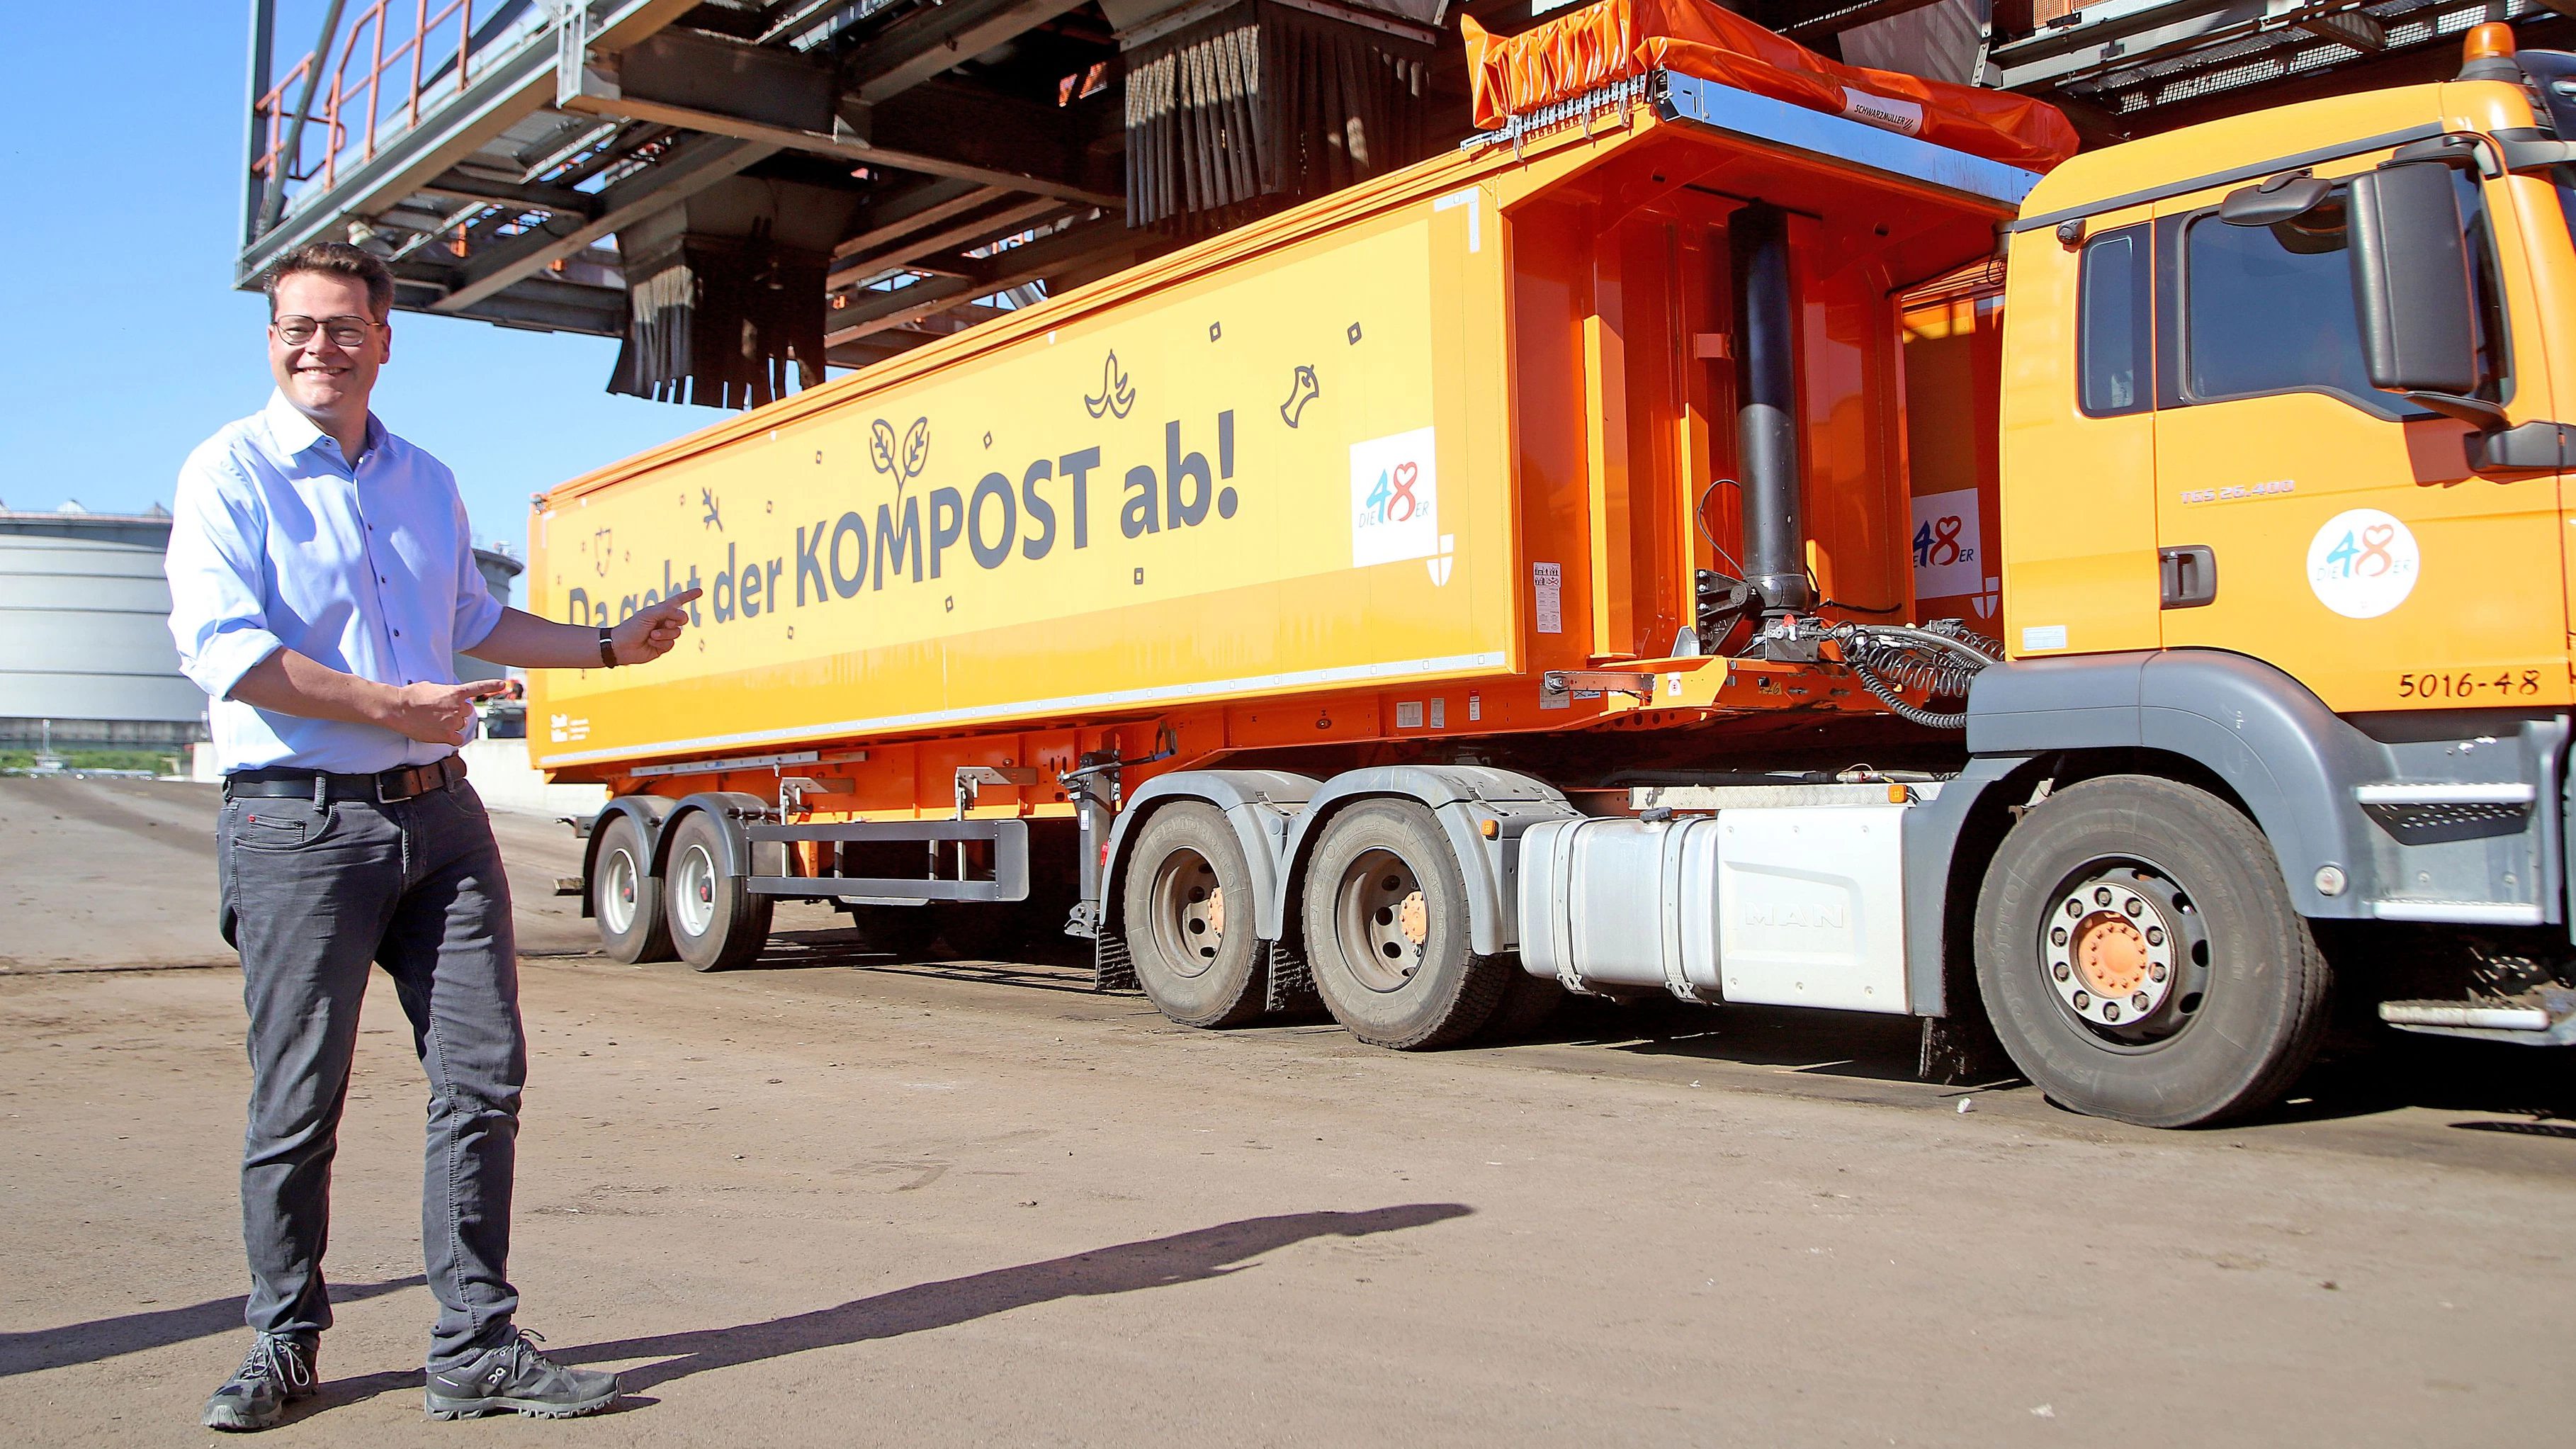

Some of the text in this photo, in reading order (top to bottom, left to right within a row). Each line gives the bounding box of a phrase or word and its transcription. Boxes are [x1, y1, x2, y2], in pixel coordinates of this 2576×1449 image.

[1854, 104, 1906, 125] SCHWARZMÜLLER
[2219, 479, 2295, 500] 26.400
[713, 542, 782, 624] der
[796, 446, 1101, 607] KOMPOST
[1120, 409, 1238, 539] ab!
[1358, 509, 1377, 529] DIE
[2397, 669, 2542, 699] 5016-48
[1745, 901, 1845, 928] MAN
